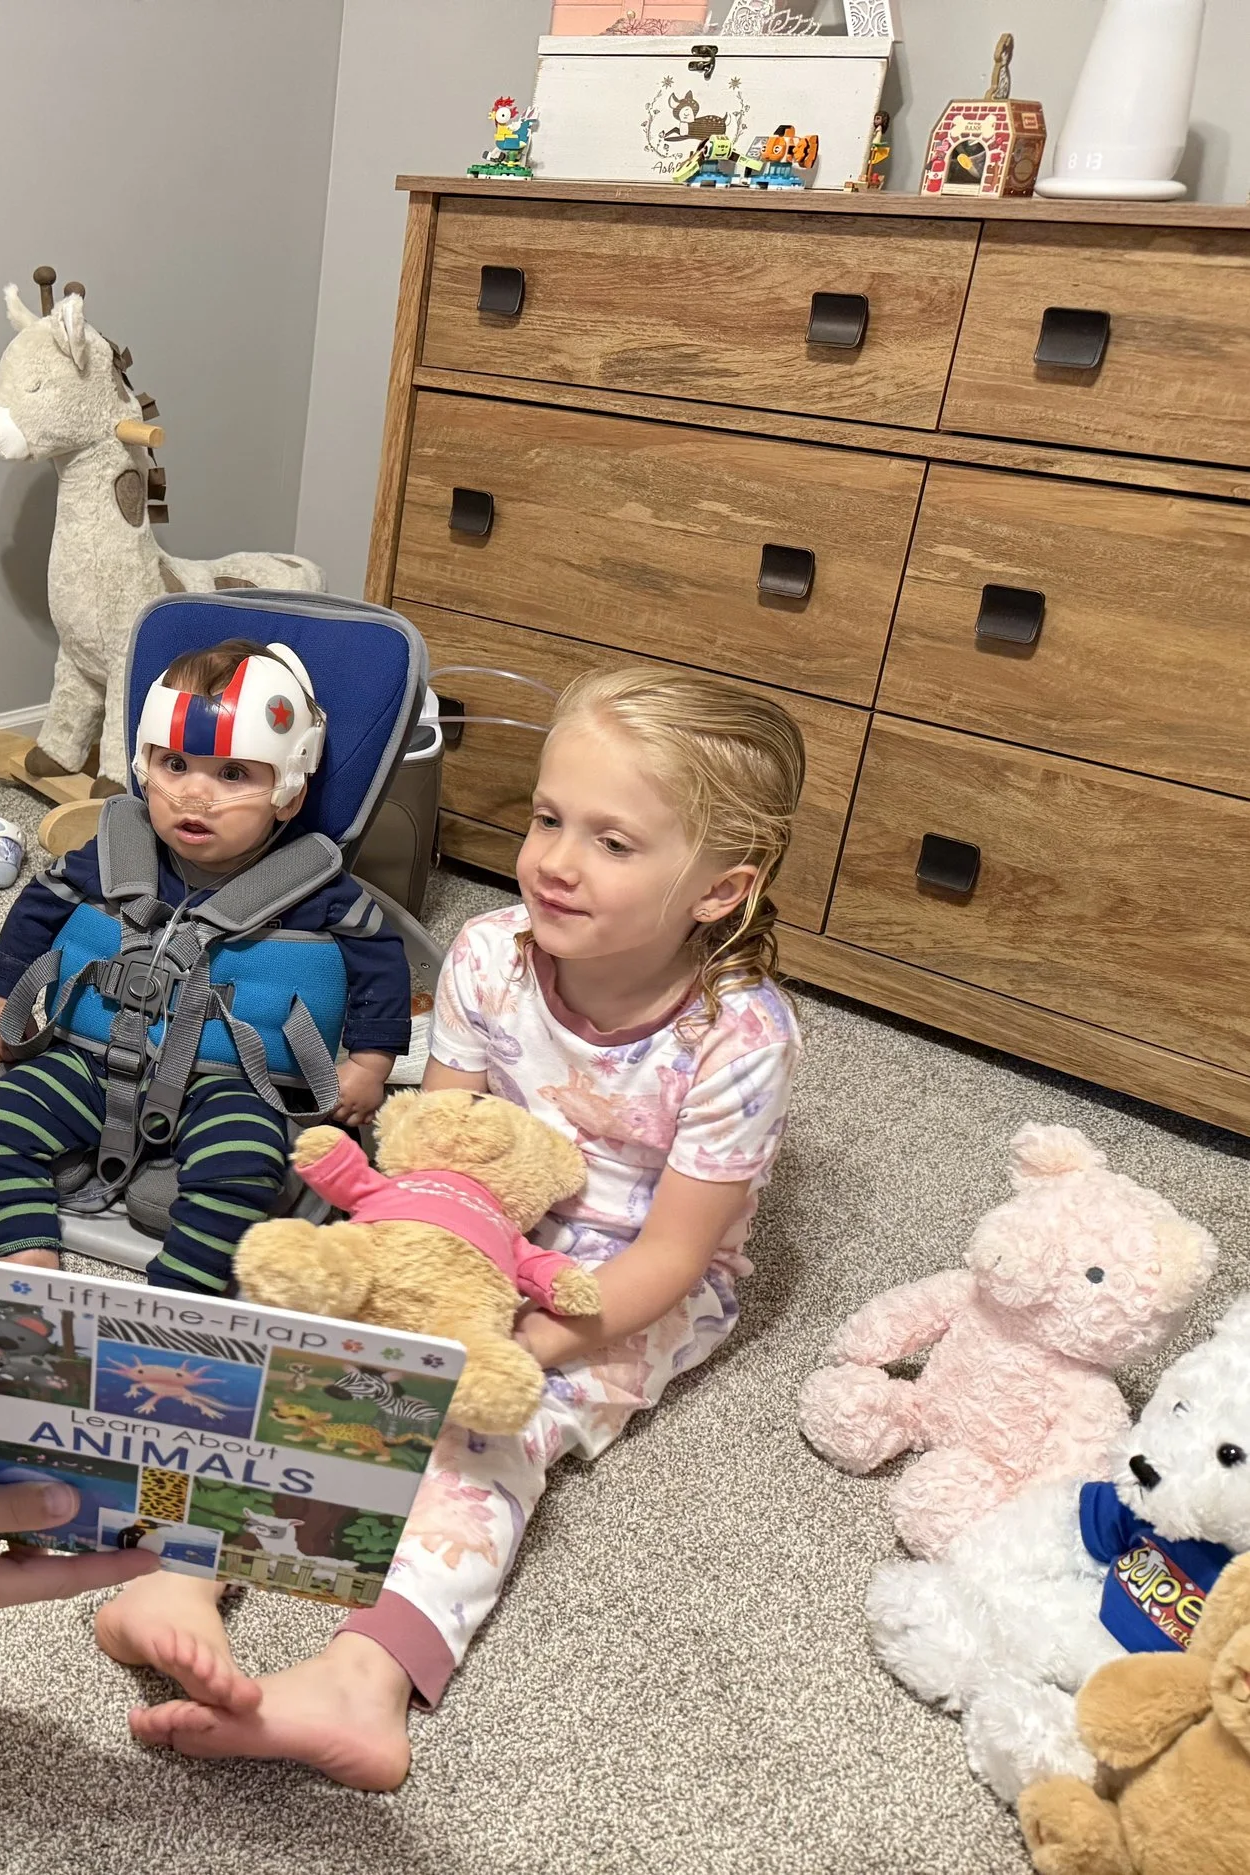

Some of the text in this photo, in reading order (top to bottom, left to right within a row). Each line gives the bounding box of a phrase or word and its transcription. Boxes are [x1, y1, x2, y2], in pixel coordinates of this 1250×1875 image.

[47, 1283, 329, 1352] Lift-the-Flap
[28, 1421, 317, 1495] ANIMALS
[71, 1410, 279, 1463] Learn About
